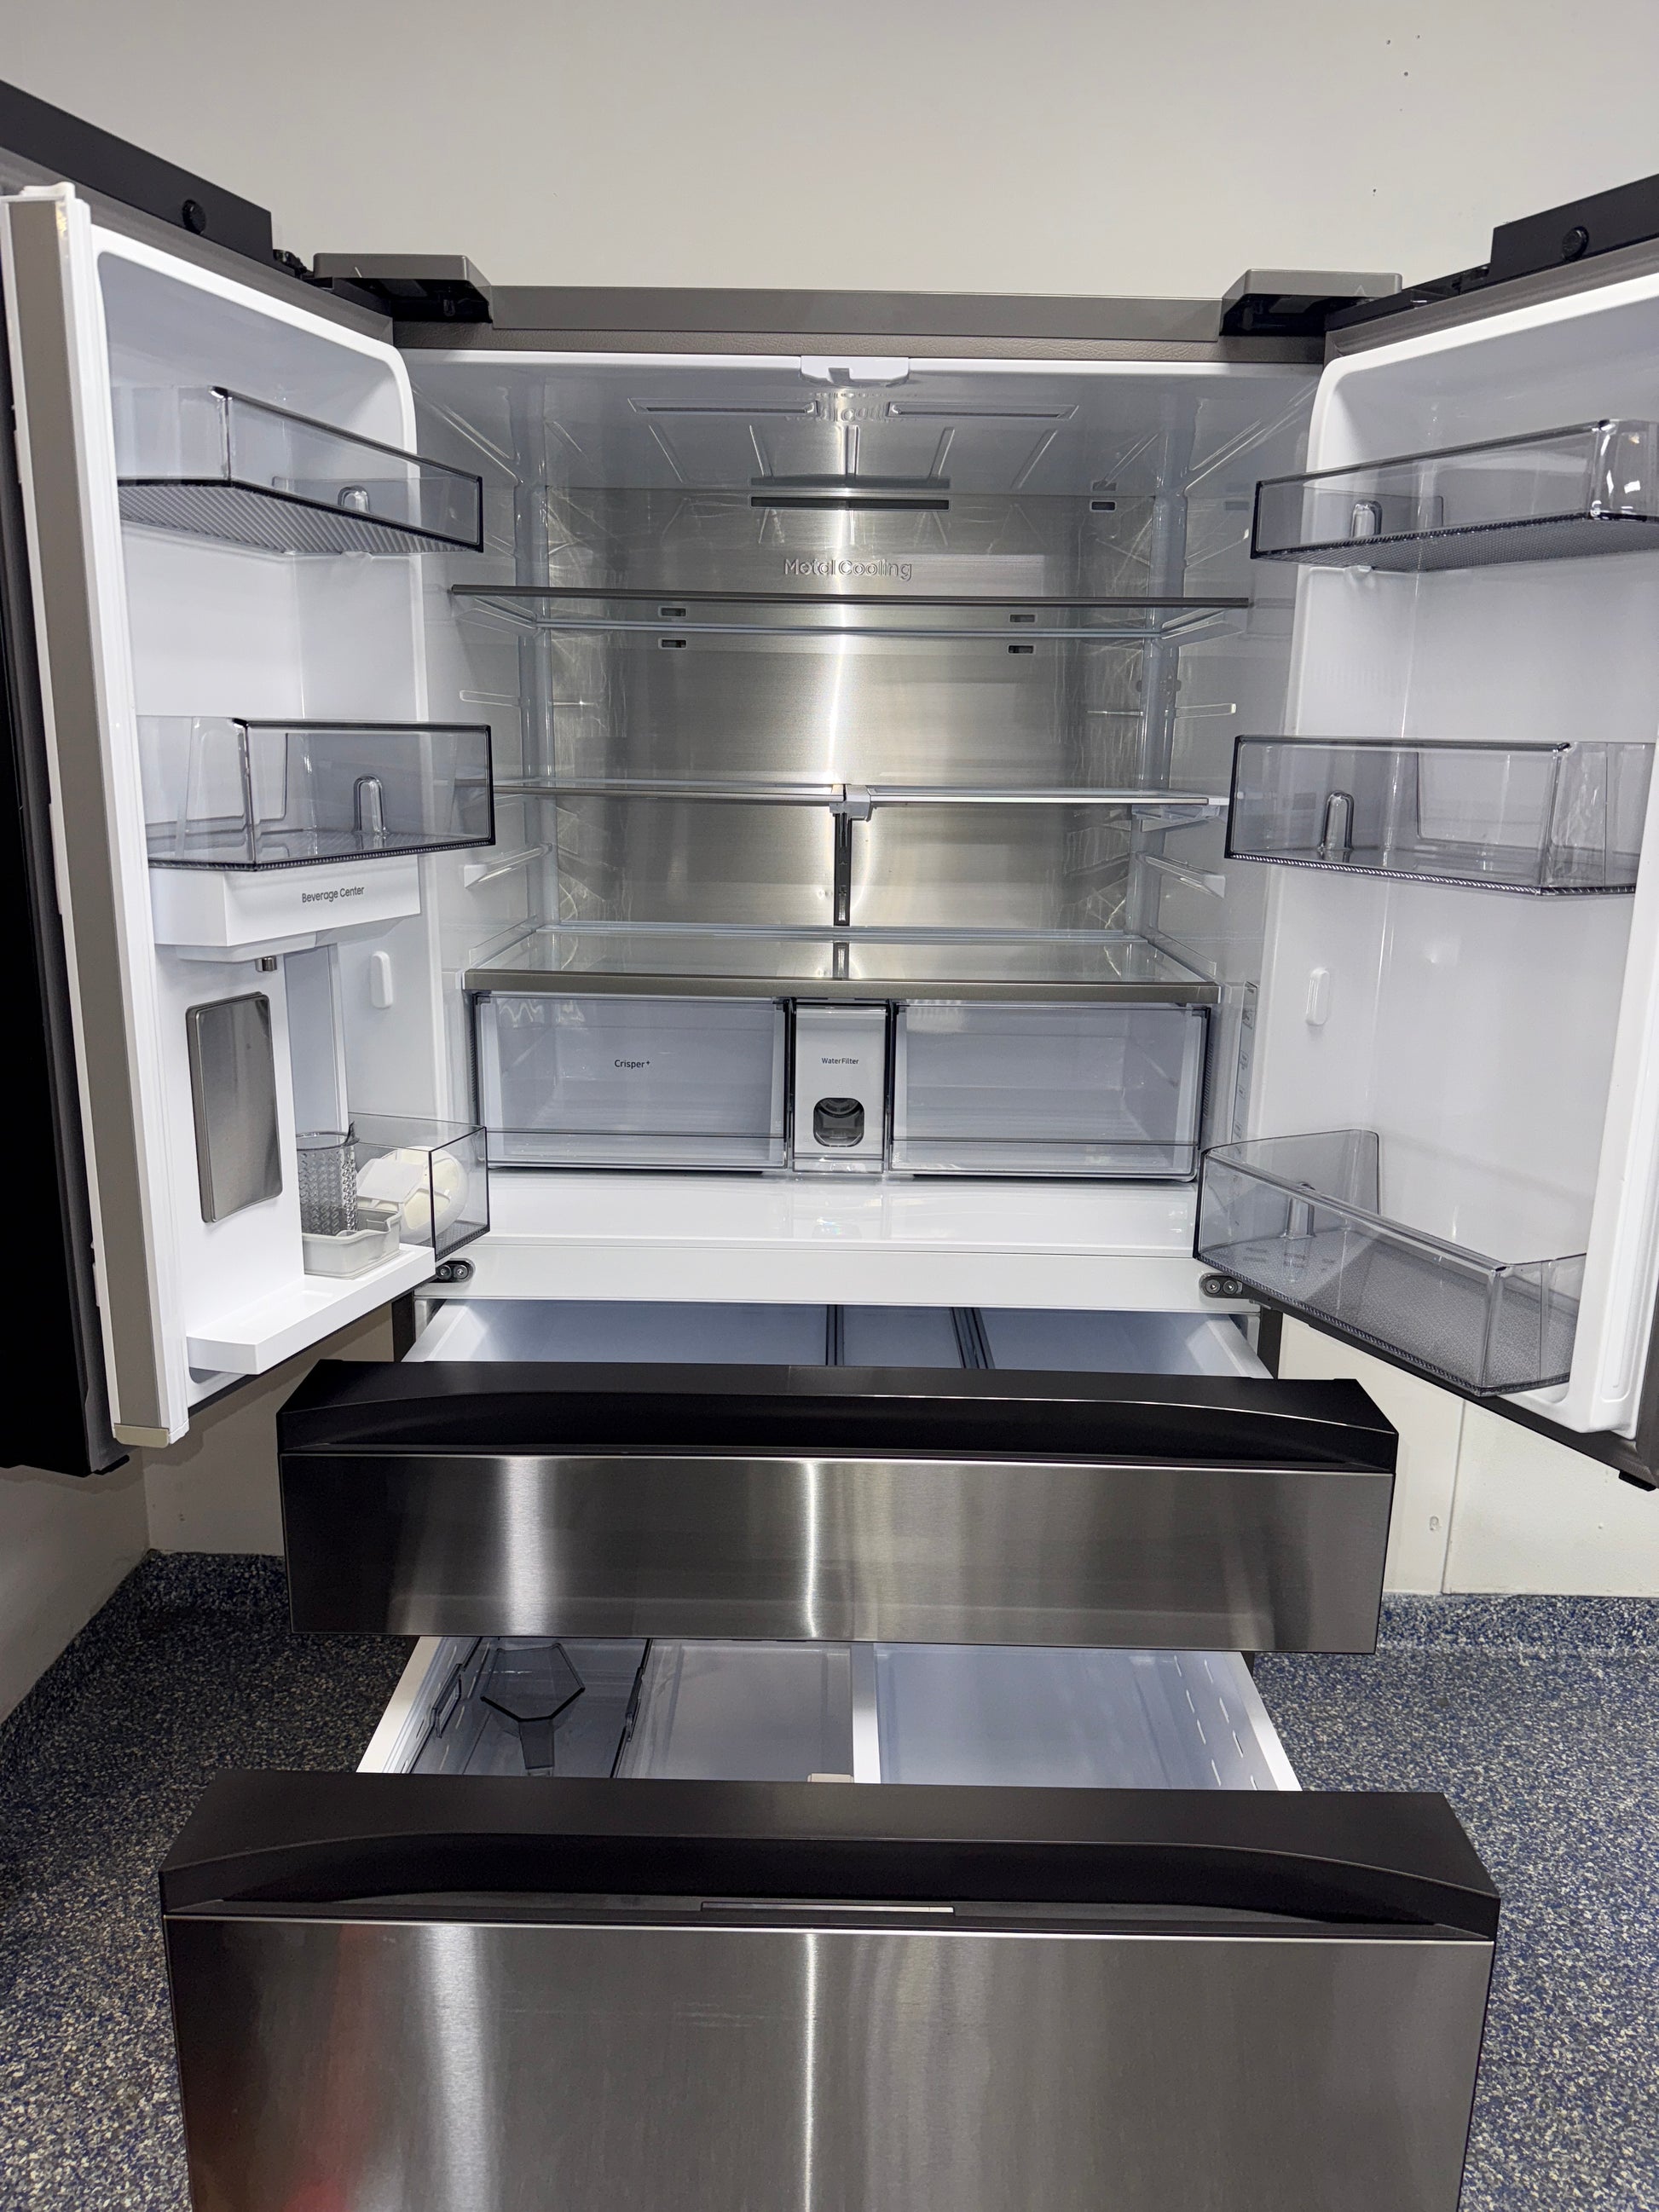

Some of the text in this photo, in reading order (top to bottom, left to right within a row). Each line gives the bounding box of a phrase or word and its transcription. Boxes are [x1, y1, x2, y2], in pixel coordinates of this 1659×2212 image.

[784, 559, 912, 581] Metal Cooling
[302, 887, 365, 903] Beverage Center
